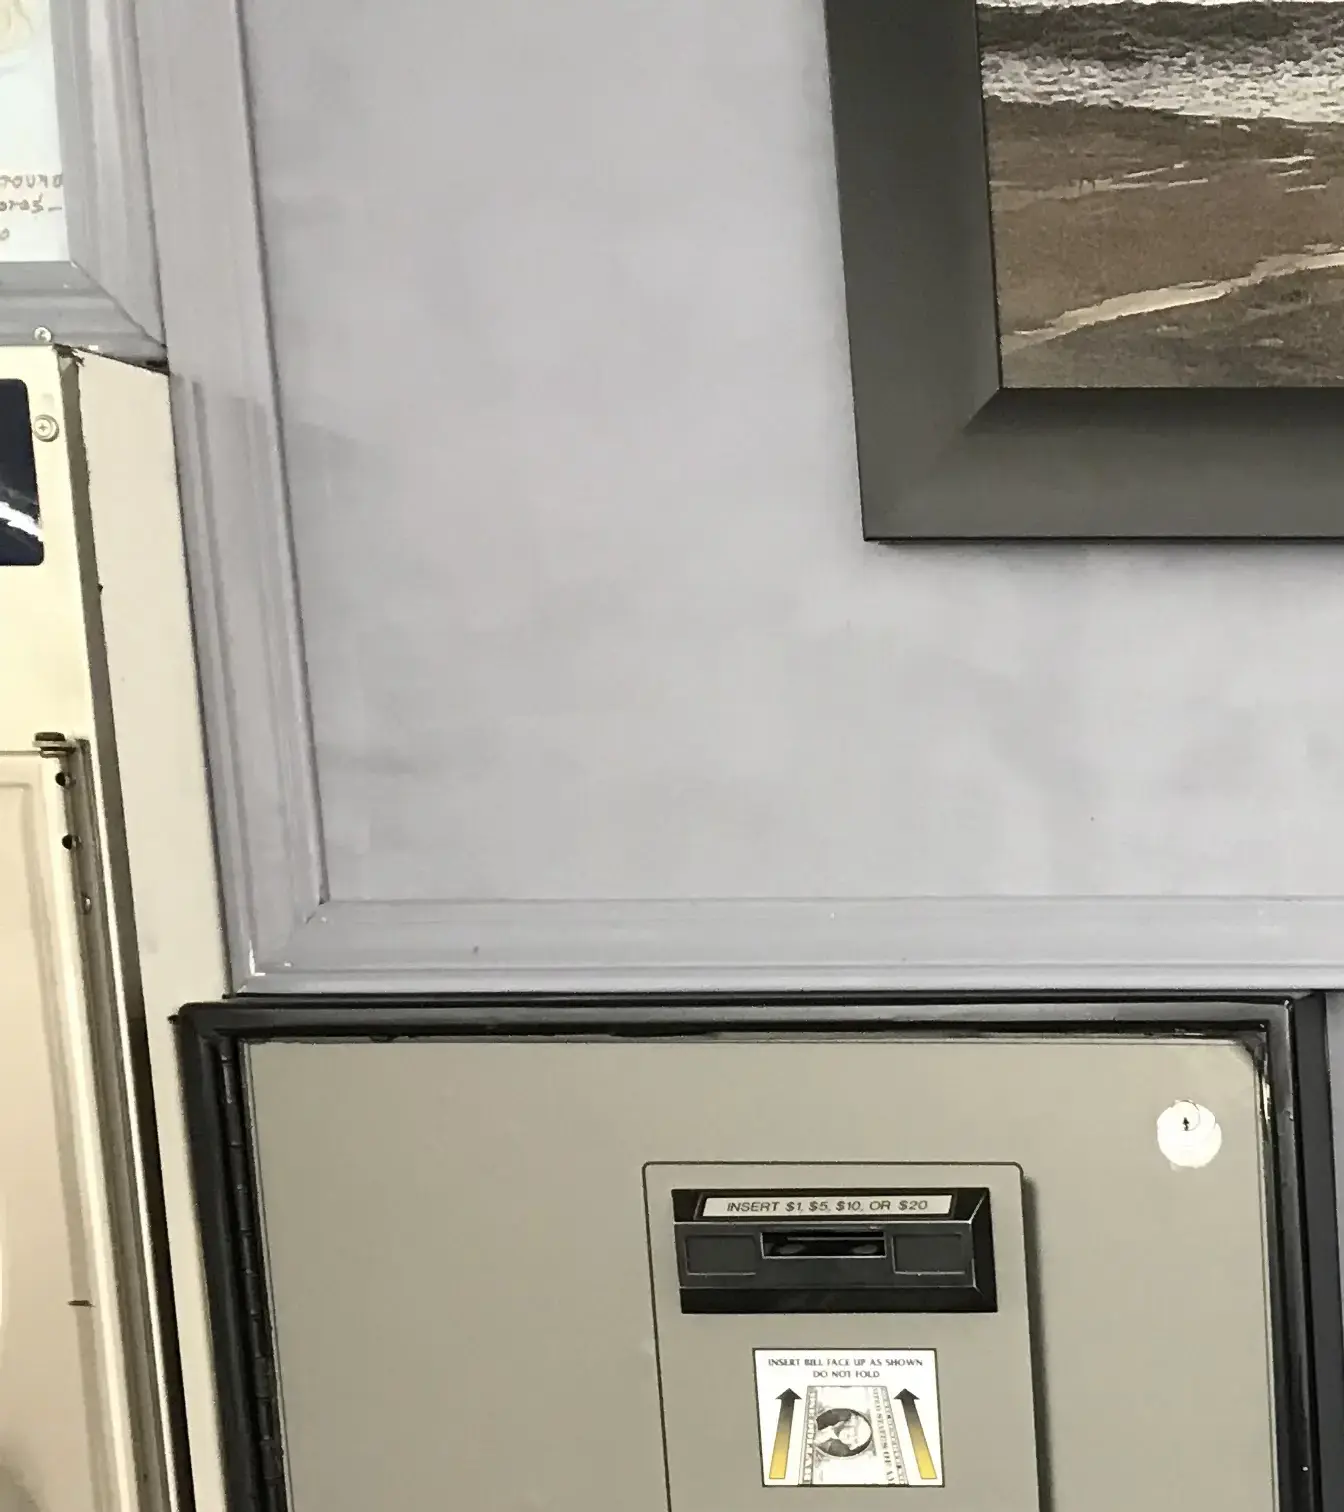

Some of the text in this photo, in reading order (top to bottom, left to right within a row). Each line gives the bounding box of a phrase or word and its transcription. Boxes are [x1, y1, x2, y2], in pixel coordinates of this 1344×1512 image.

[726, 1200, 780, 1213] INSERT
[868, 1200, 892, 1212] OR
[898, 1199, 929, 1211] $20
[768, 1358, 923, 1367] INSERT BILL FACE UP AS SHOWN
[813, 1370, 880, 1378] DO NOT FOLD
